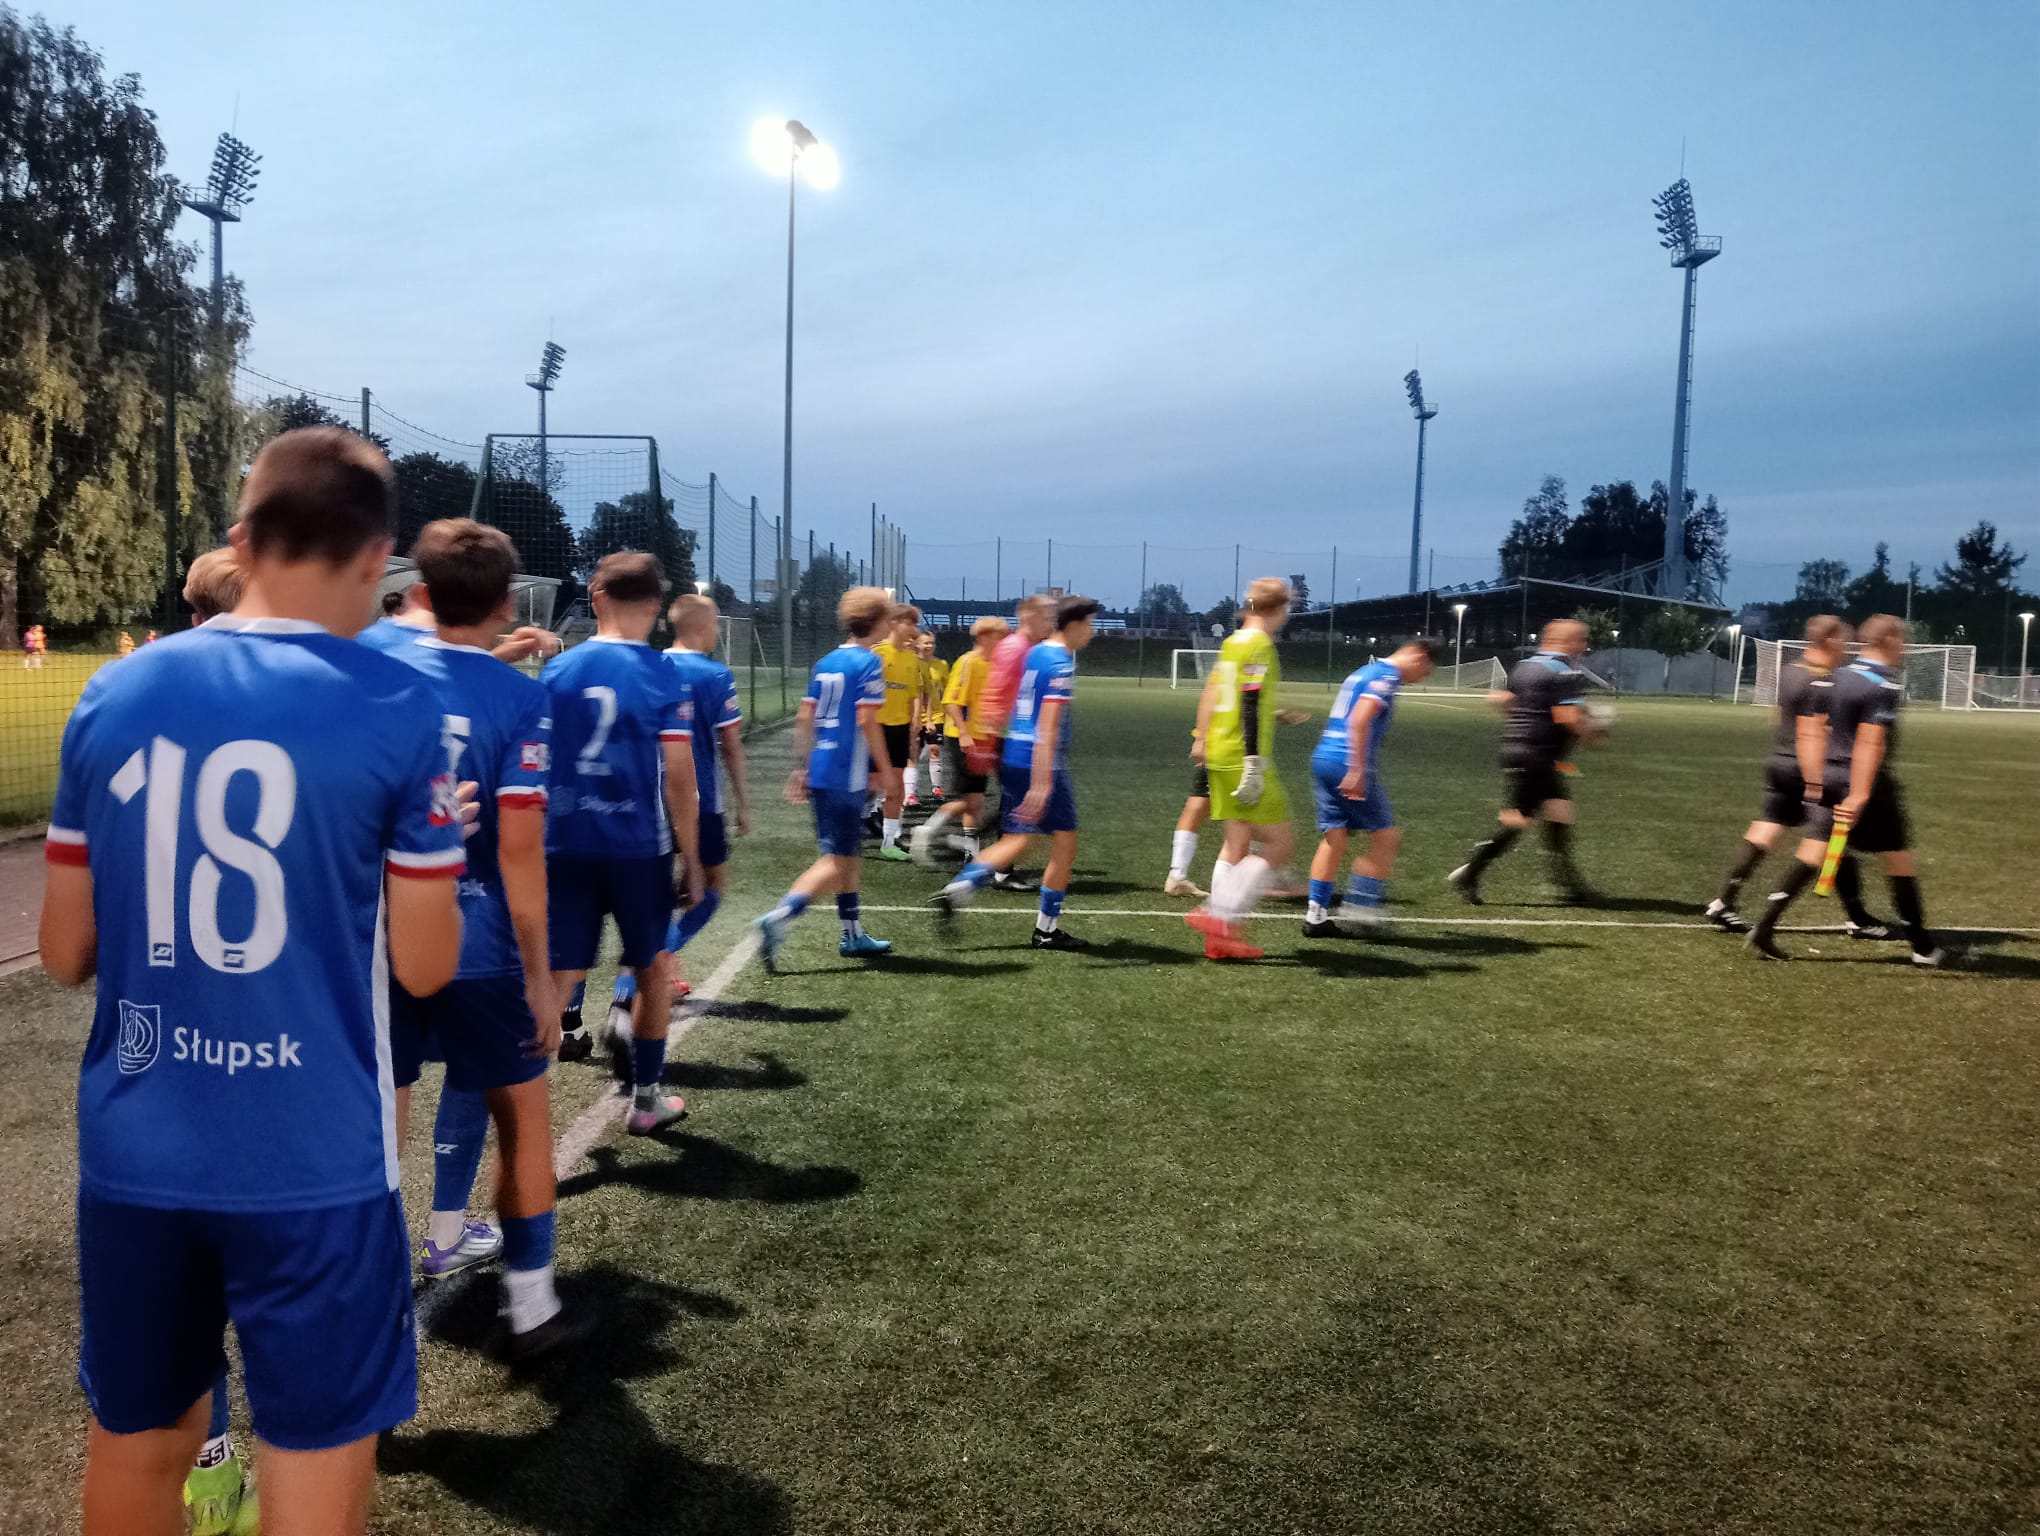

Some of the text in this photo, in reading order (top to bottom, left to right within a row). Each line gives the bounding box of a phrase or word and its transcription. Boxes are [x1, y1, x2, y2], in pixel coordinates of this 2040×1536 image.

[575, 686, 616, 776] 2
[109, 735, 297, 974] 18
[173, 1026, 302, 1076] Słupsk
